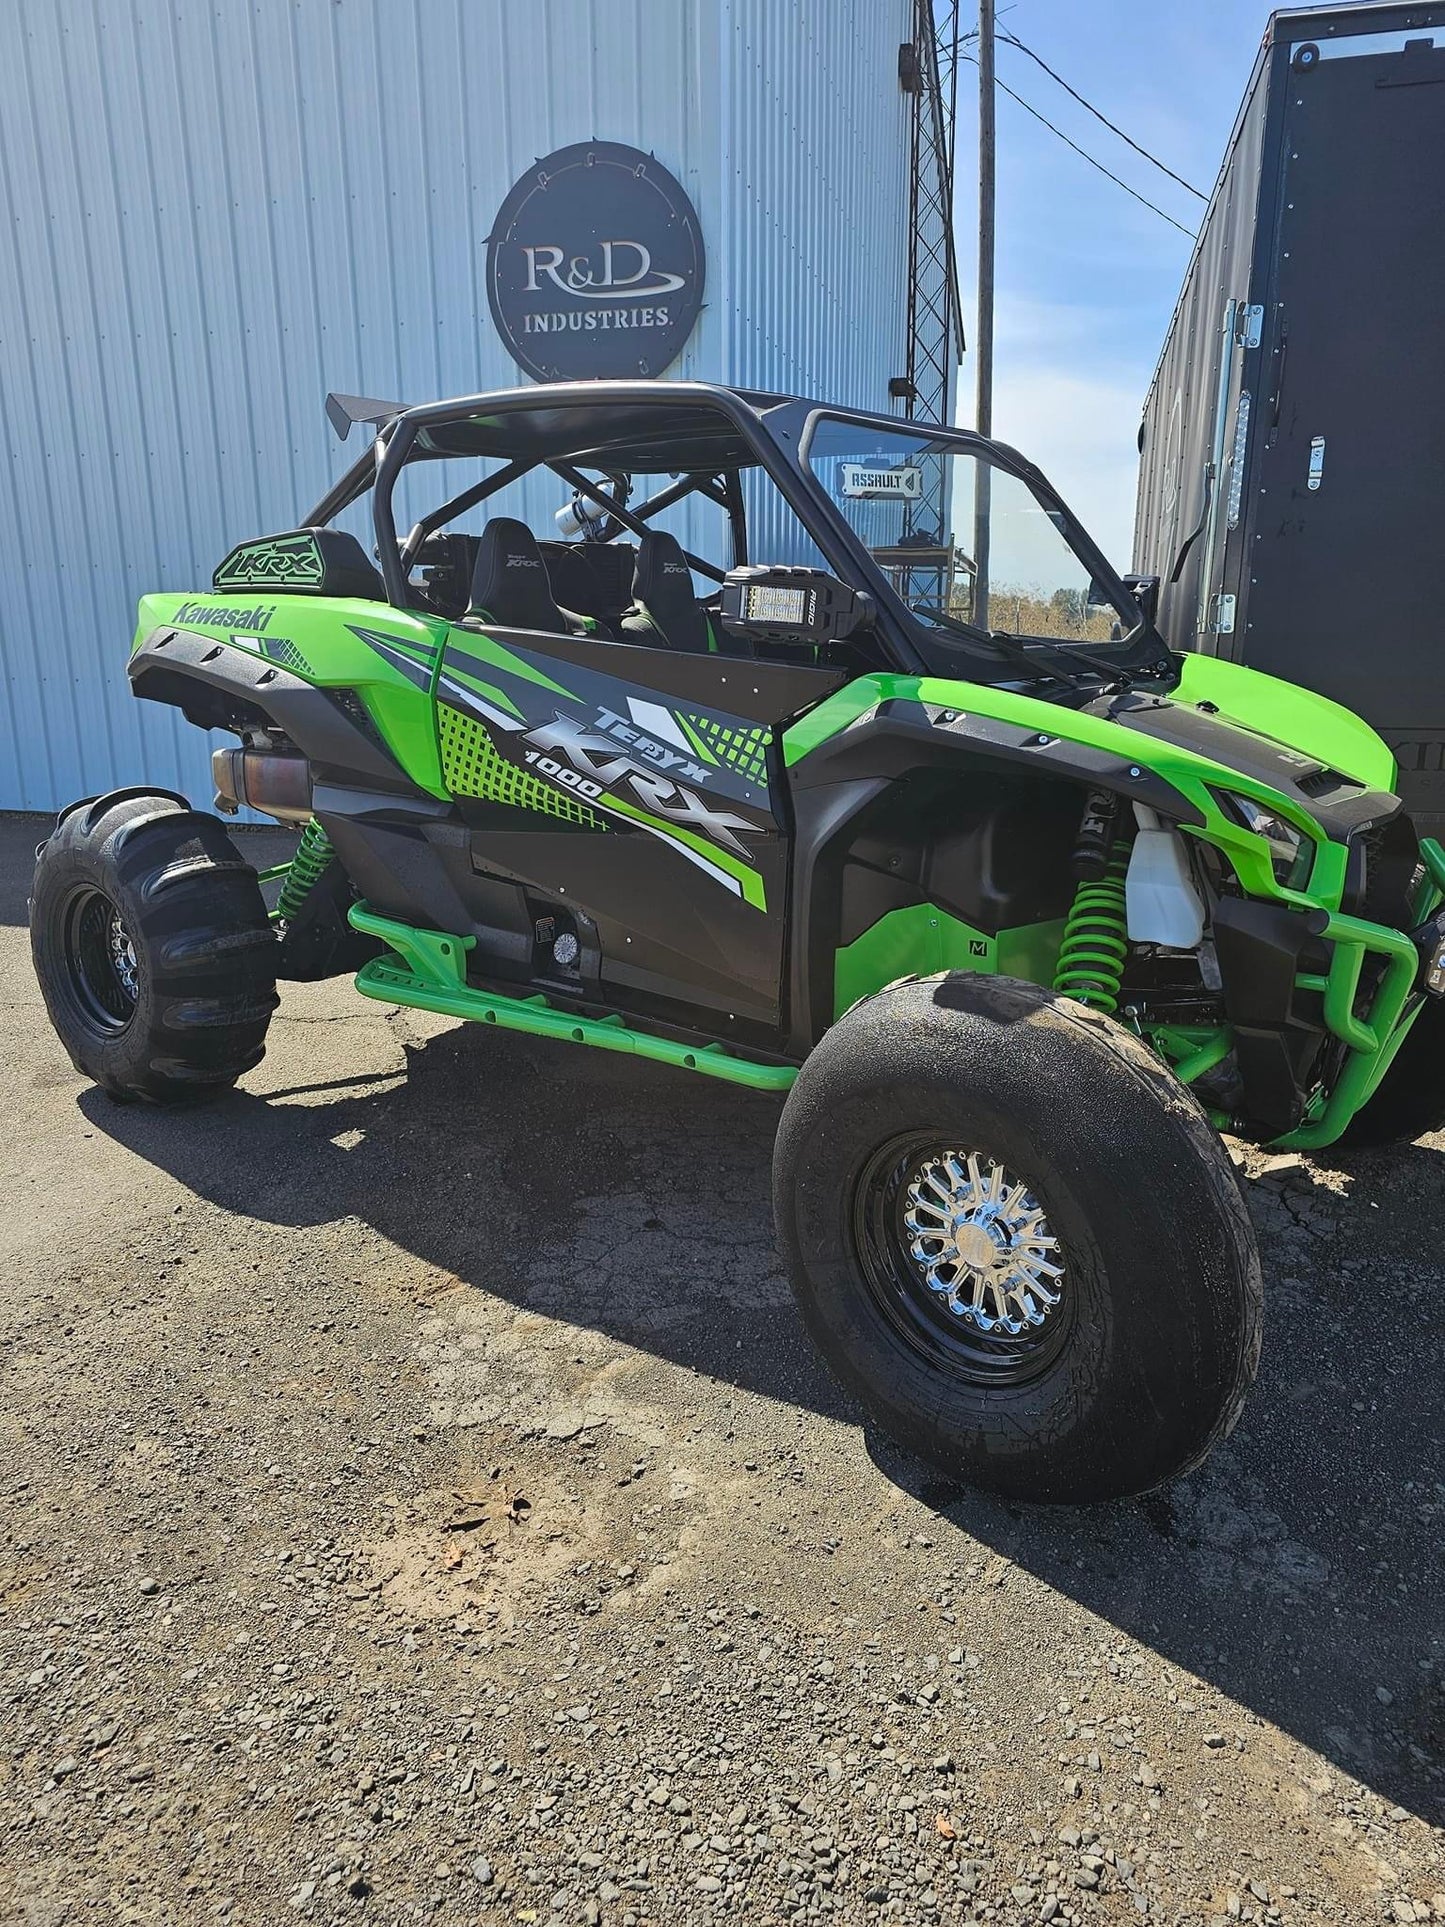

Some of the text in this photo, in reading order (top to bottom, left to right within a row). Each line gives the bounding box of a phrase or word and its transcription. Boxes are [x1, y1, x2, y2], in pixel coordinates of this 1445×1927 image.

[520, 240, 686, 299] R&D
[851, 472, 902, 489] ASSAULT
[233, 551, 321, 576] KRX
[171, 602, 277, 632] Kawasaki
[807, 588, 818, 626] RIGID
[593, 705, 713, 784] TERYX
[520, 710, 768, 861] KRX
[525, 750, 603, 798] 1000
